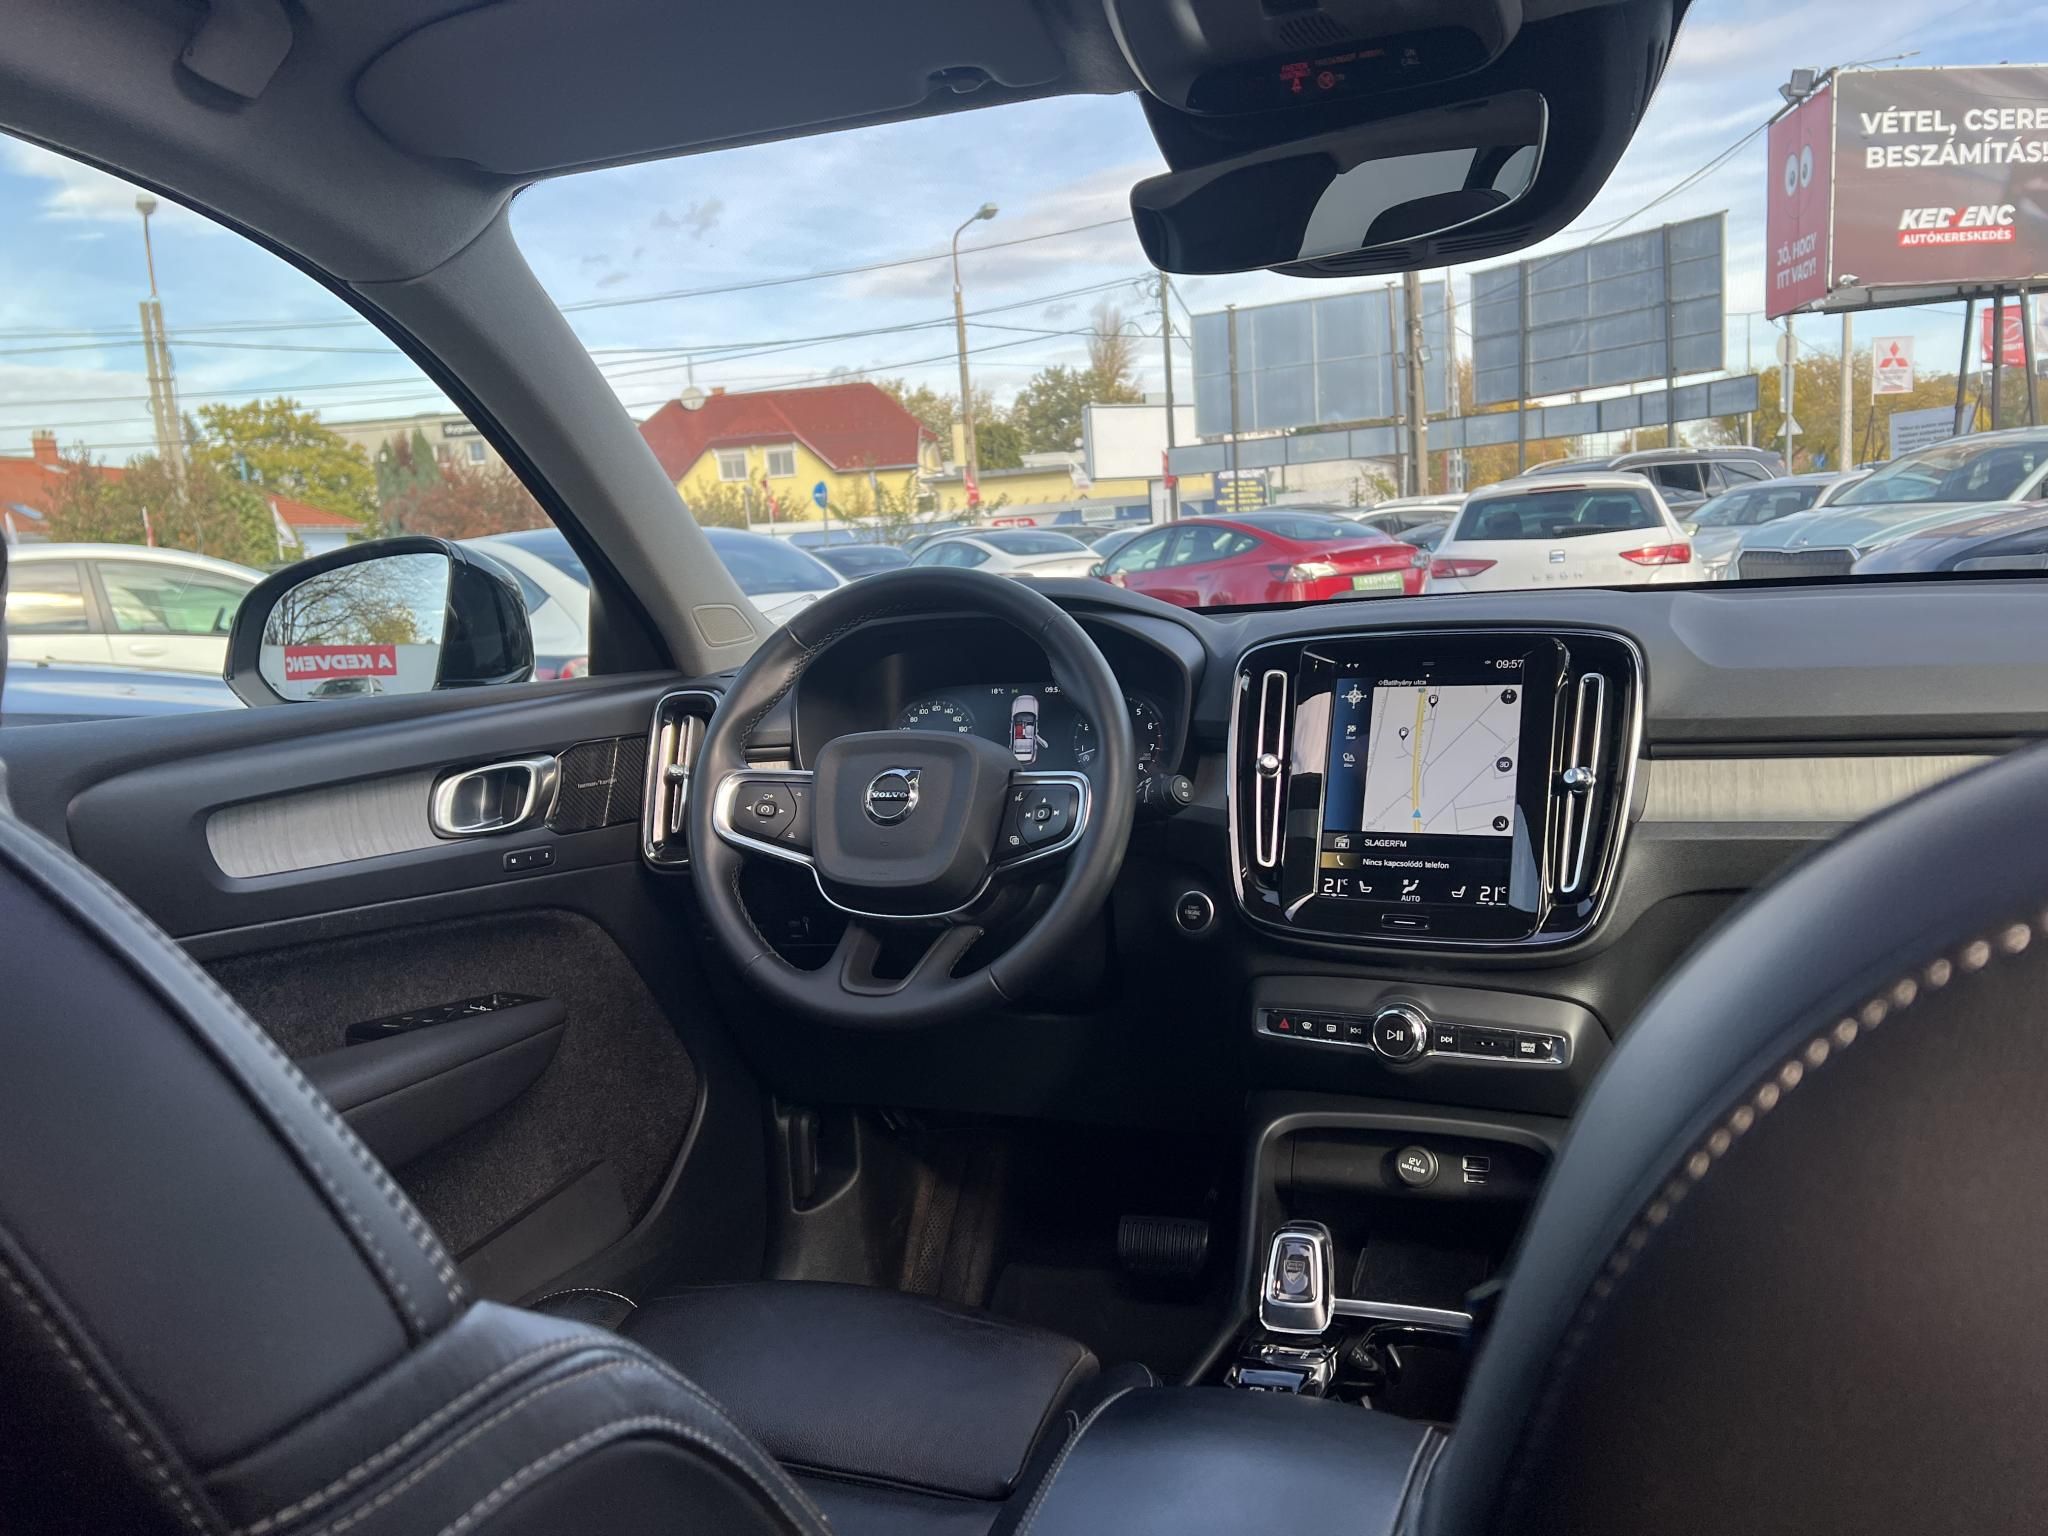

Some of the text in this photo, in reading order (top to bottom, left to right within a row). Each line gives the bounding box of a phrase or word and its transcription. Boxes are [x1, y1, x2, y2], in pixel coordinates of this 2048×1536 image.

[1860, 106, 2048, 136] VÉTEL, CSERE
[1866, 136, 2048, 168] BESZÁMÍTÁS!
[1902, 228, 2013, 244] AUTÓKERESKEDÉS
[1792, 231, 1817, 260] HOGY
[1777, 256, 1817, 289] ITT VAGY!
[1495, 659, 1524, 669] 09:57
[1136, 708, 1142, 716] 5
[1147, 722, 1153, 730] 6
[1149, 743, 1155, 751] 7
[1499, 761, 1510, 769] 3D
[1364, 839, 1407, 848] SLAGERFM
[1362, 858, 1450, 870] Nincs kapcsolódó telefon
[1401, 895, 1421, 903] AUTO
